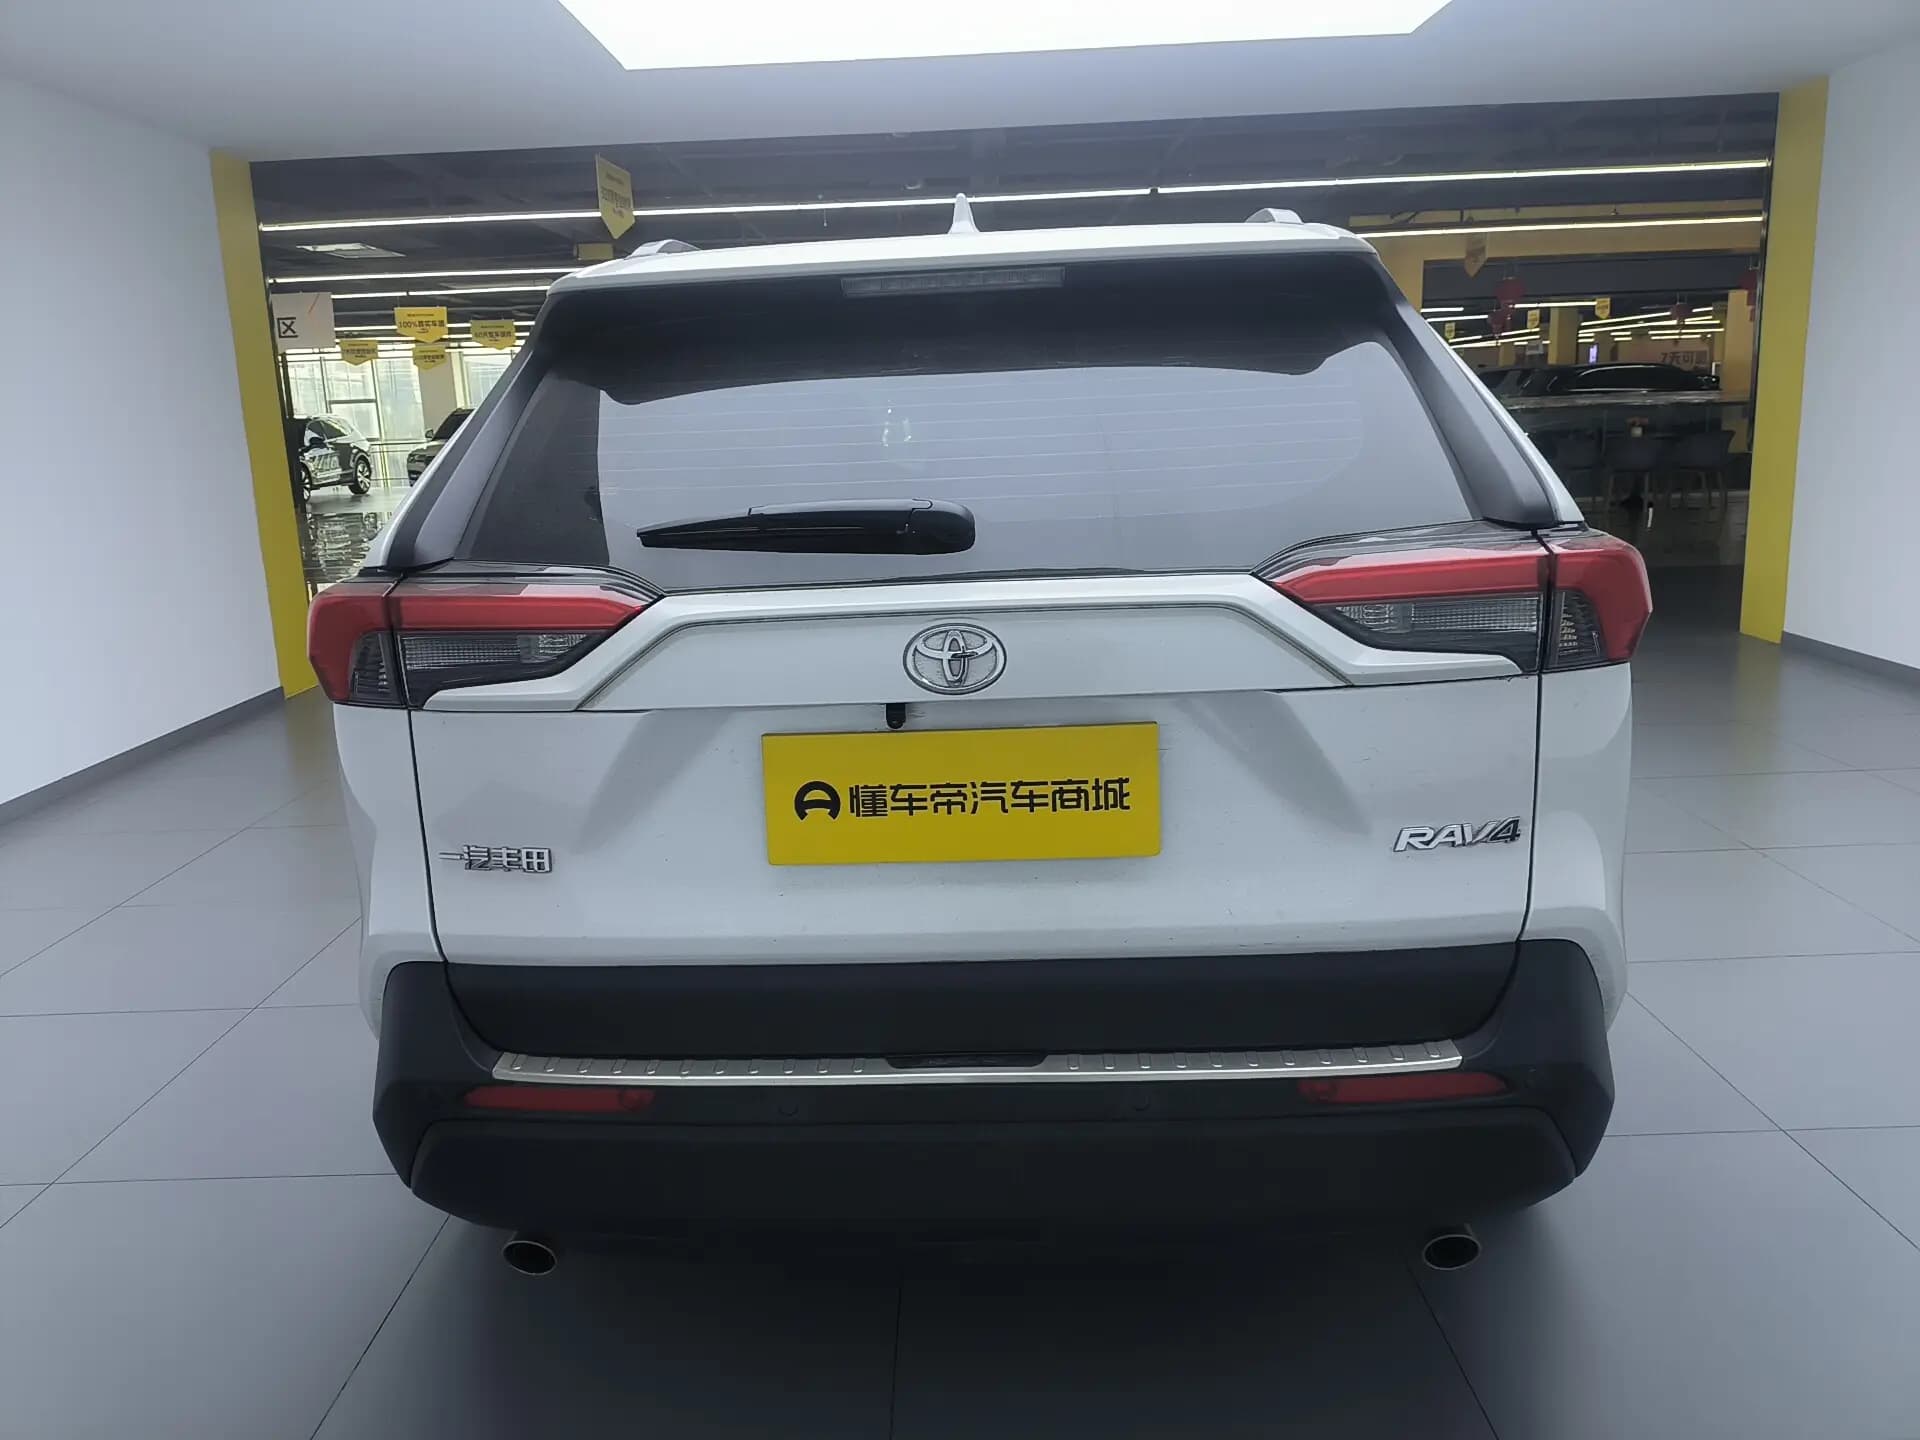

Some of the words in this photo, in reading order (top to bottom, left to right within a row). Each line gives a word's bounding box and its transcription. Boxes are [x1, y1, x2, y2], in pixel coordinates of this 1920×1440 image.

[849, 777, 1131, 818] 懂车帝汽车商城
[1393, 816, 1521, 852] RAV4
[438, 845, 552, 873] 一汽丰田
